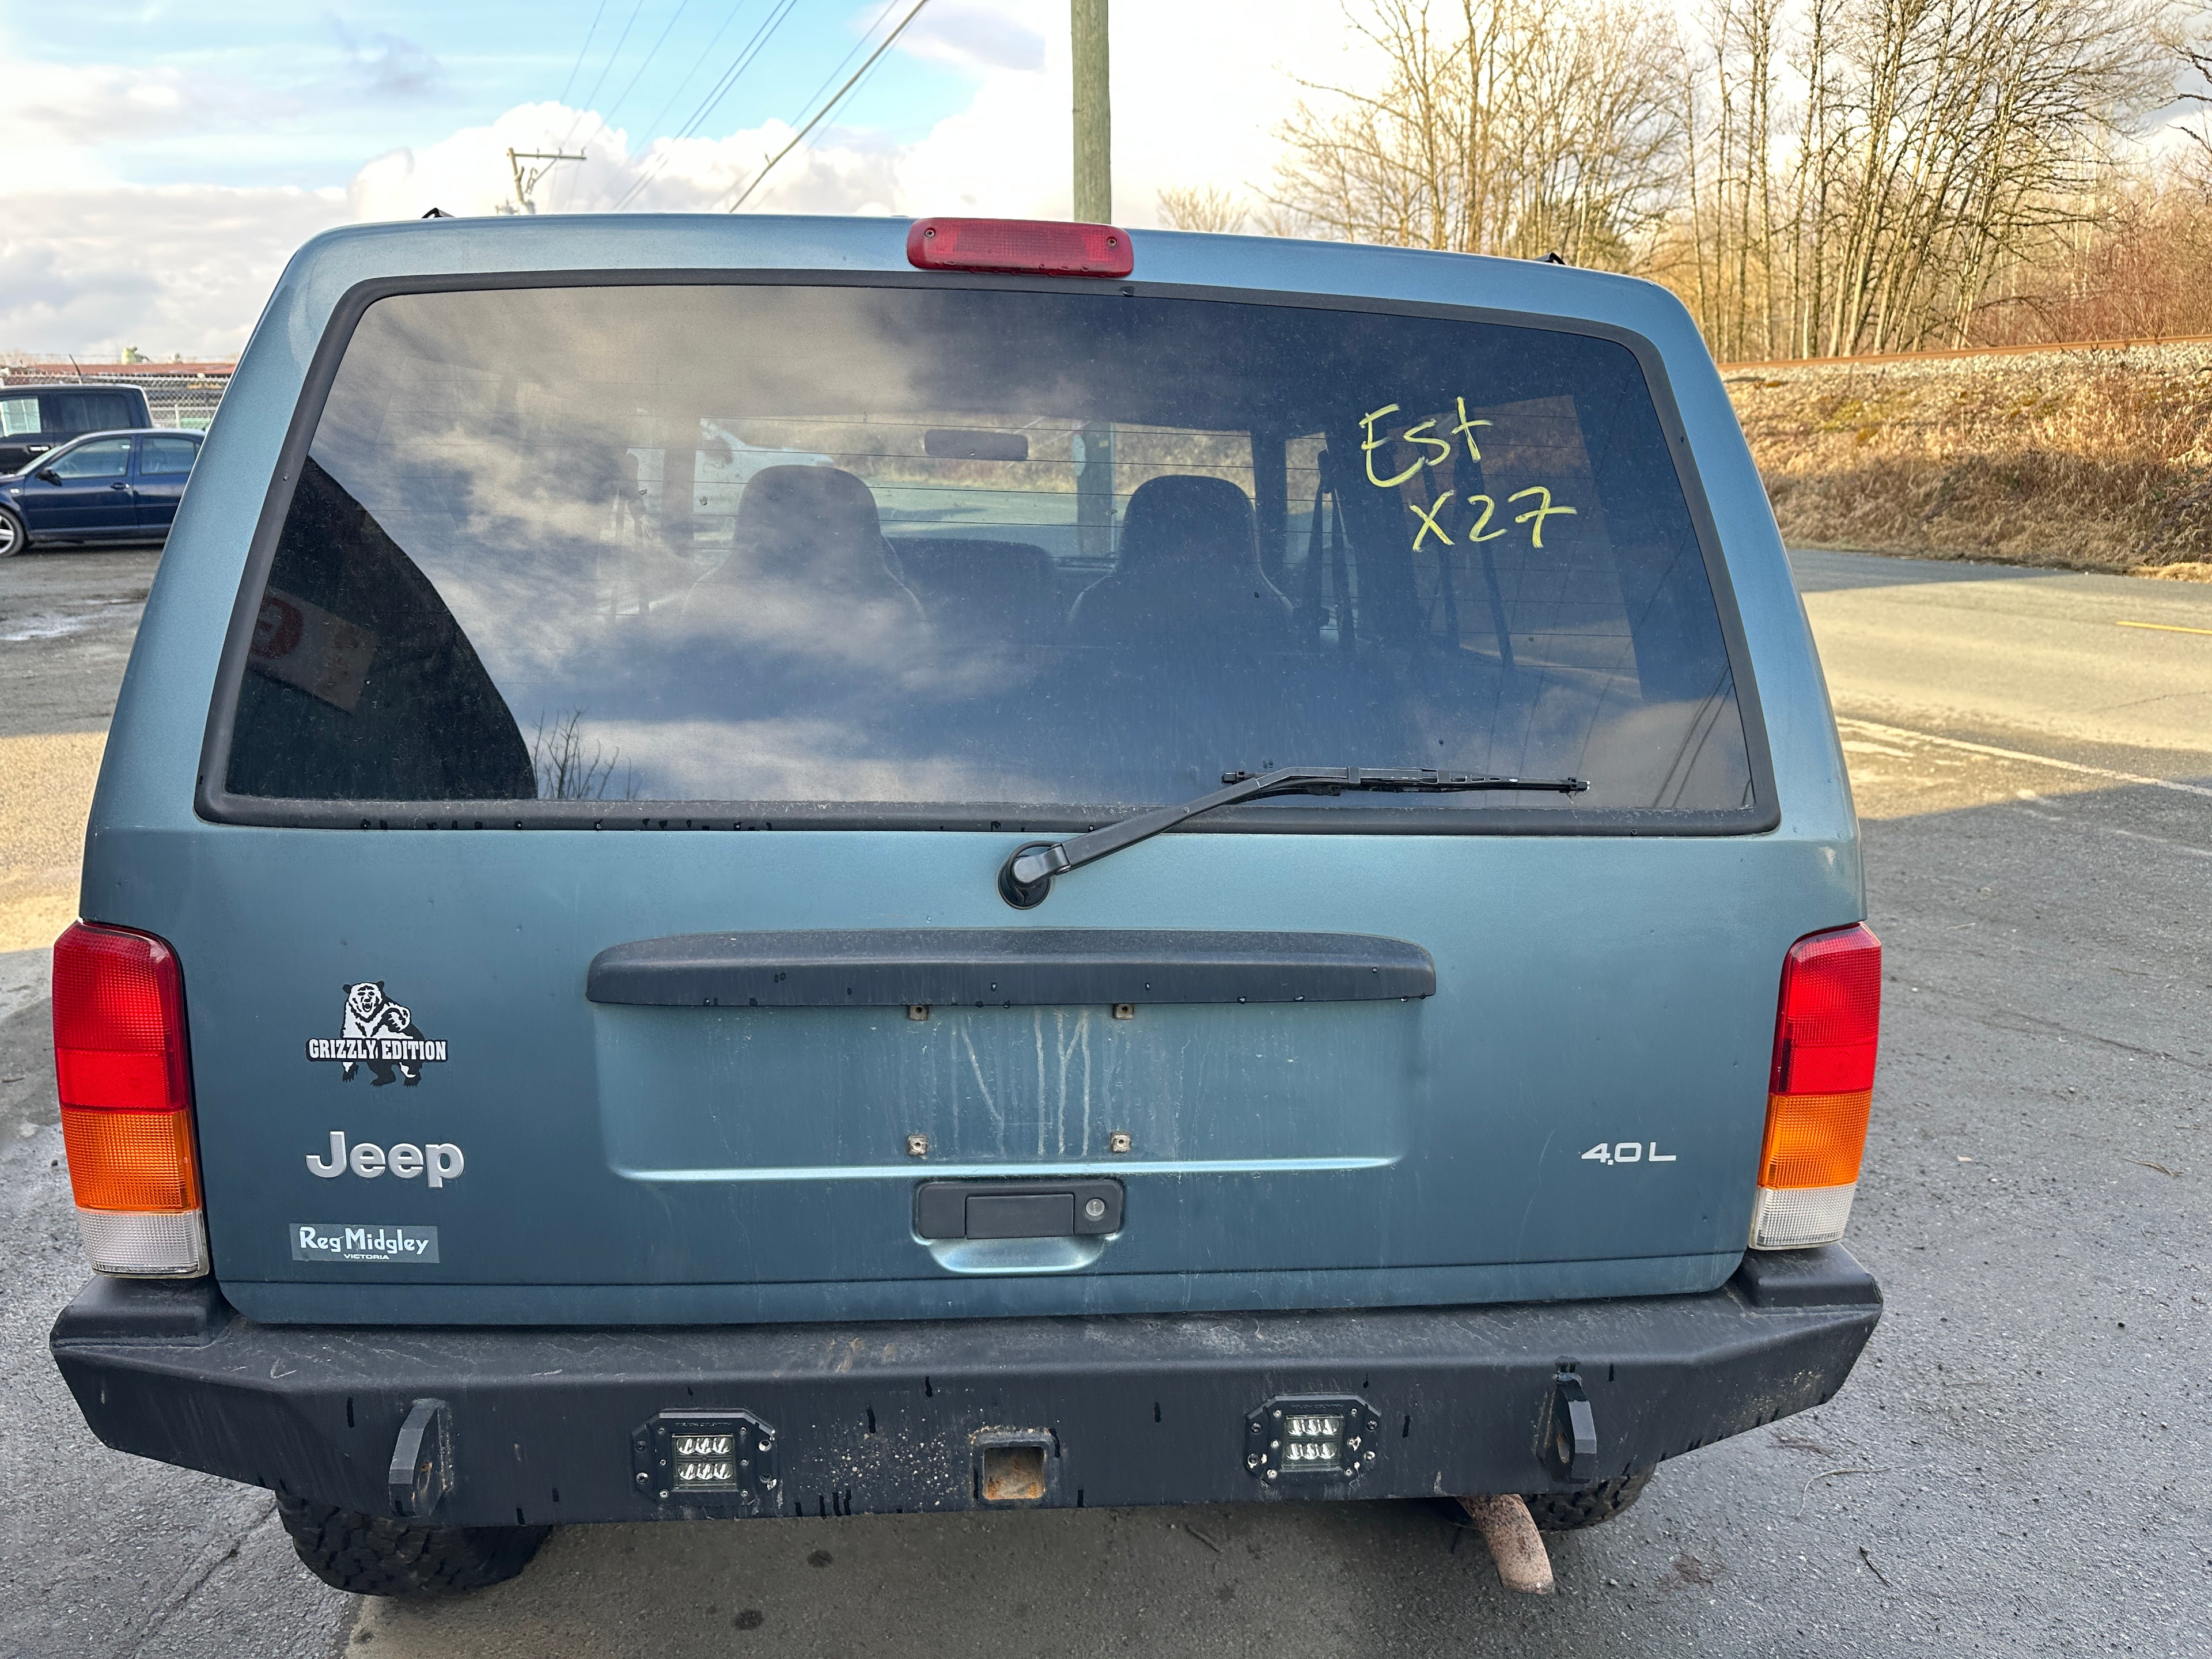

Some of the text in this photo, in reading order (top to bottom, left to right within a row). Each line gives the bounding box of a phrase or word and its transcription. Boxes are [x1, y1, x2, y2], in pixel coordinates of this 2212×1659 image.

[1359, 396, 1493, 487] Est
[309, 1039, 446, 1060] GRIZZLY EDITION
[306, 1131, 464, 1188] Jeep
[300, 1226, 429, 1255] Reg Midgley
